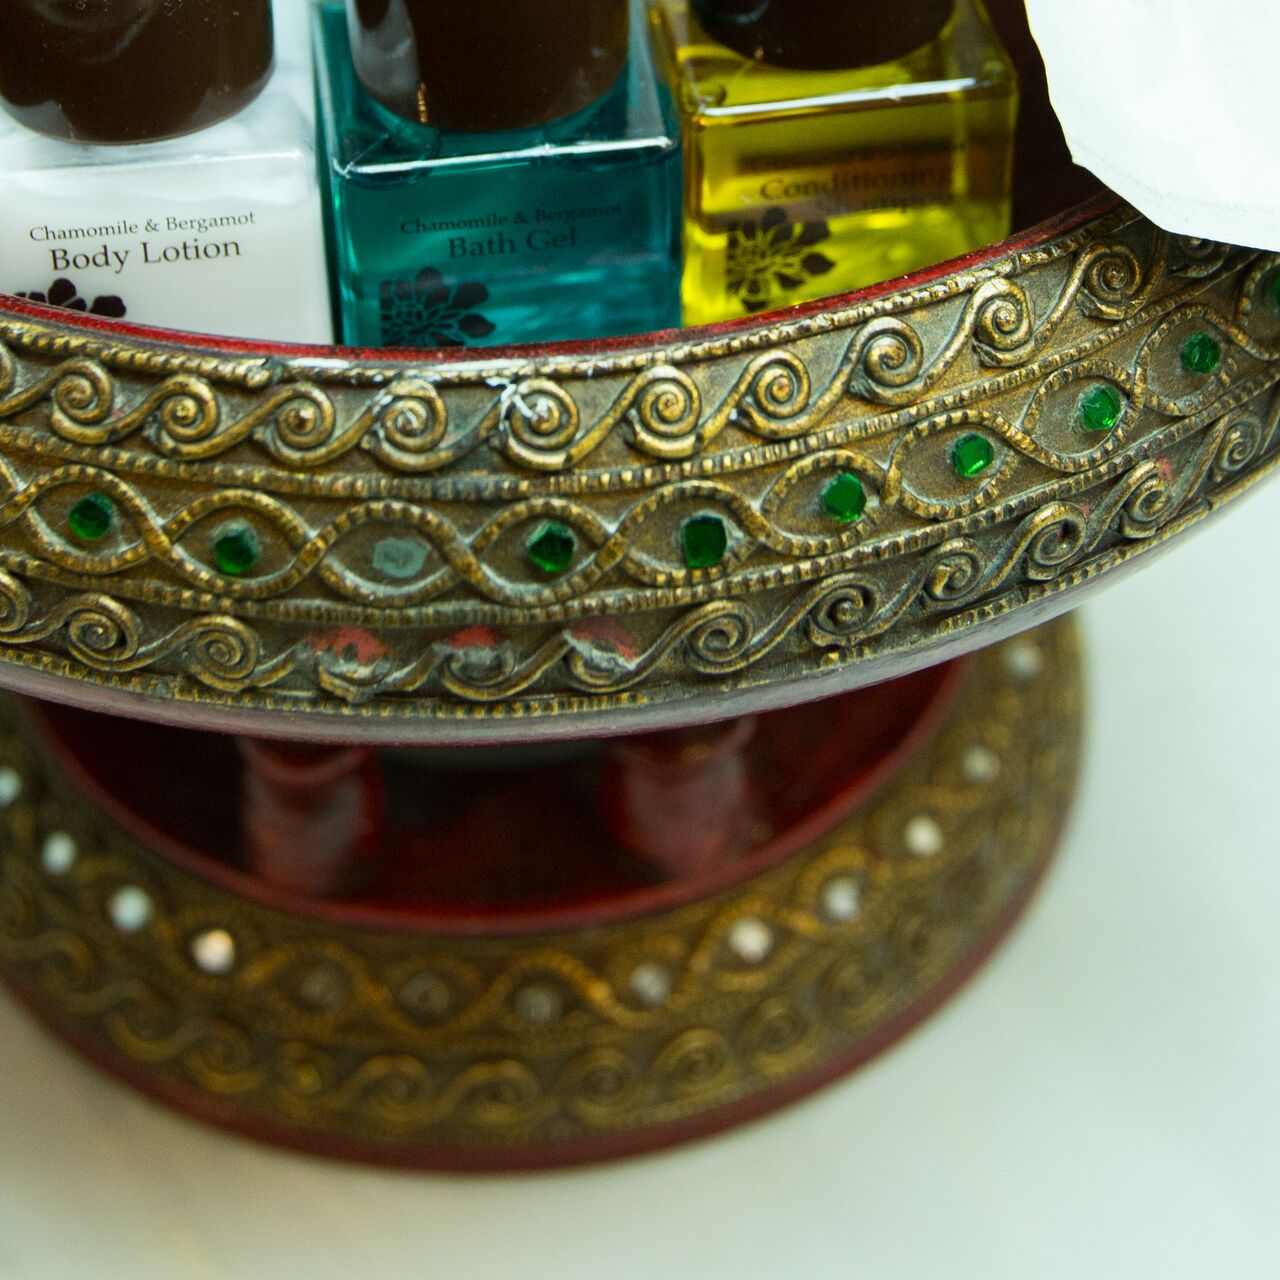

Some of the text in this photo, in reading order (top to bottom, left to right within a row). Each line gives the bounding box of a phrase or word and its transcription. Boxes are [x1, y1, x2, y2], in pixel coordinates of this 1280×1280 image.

[29, 211, 256, 242] Chamomile & Bergamot
[400, 203, 622, 235] Chamomile & Bergamot
[49, 237, 242, 275] Body Lotion
[448, 226, 578, 259] Bath Gel
